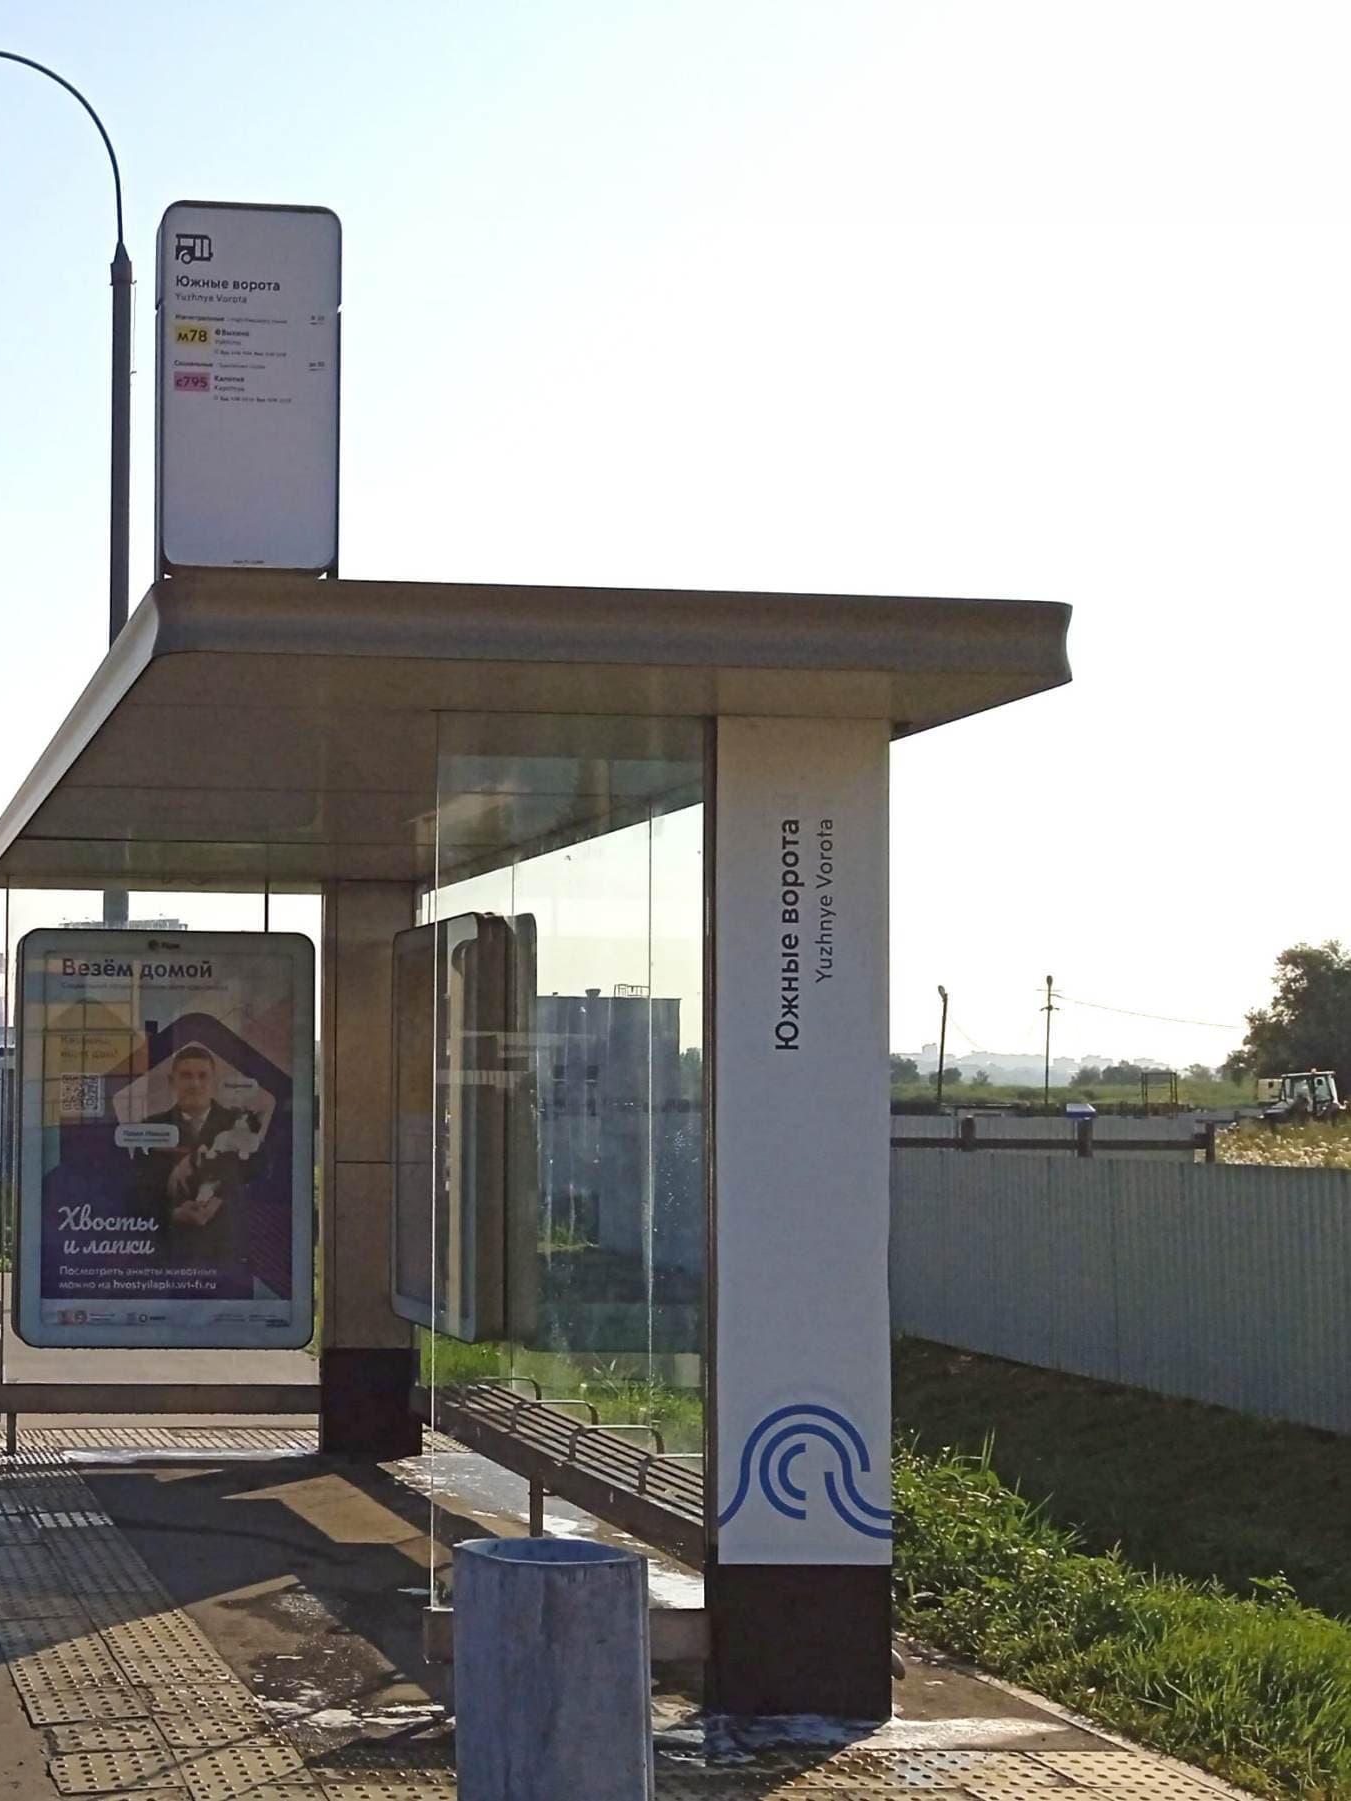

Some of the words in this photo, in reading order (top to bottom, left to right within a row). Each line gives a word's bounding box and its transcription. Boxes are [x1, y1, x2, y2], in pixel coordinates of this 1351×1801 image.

[175, 275, 229, 290] Южные
[232, 279, 281, 293] ворота
[175, 293, 214, 303] Yuzhnye
[216, 294, 248, 304] Vorota
[177, 329, 208, 342] м78
[176, 376, 208, 389] с795
[815, 818, 834, 889] Vorota
[781, 819, 805, 924] ворота
[814, 894, 837, 983] Yuzhnye
[61, 958, 134, 977] Везём
[140, 960, 213, 979] домой
[774, 932, 800, 1050] Южные
[58, 1203, 160, 1232] Хвосты
[63, 1239, 80, 1255] и
[82, 1239, 155, 1255] лапки
[59, 1265, 124, 1277] Посмотреть
[58, 1281, 96, 1290] можно
[99, 1281, 111, 1290] на
